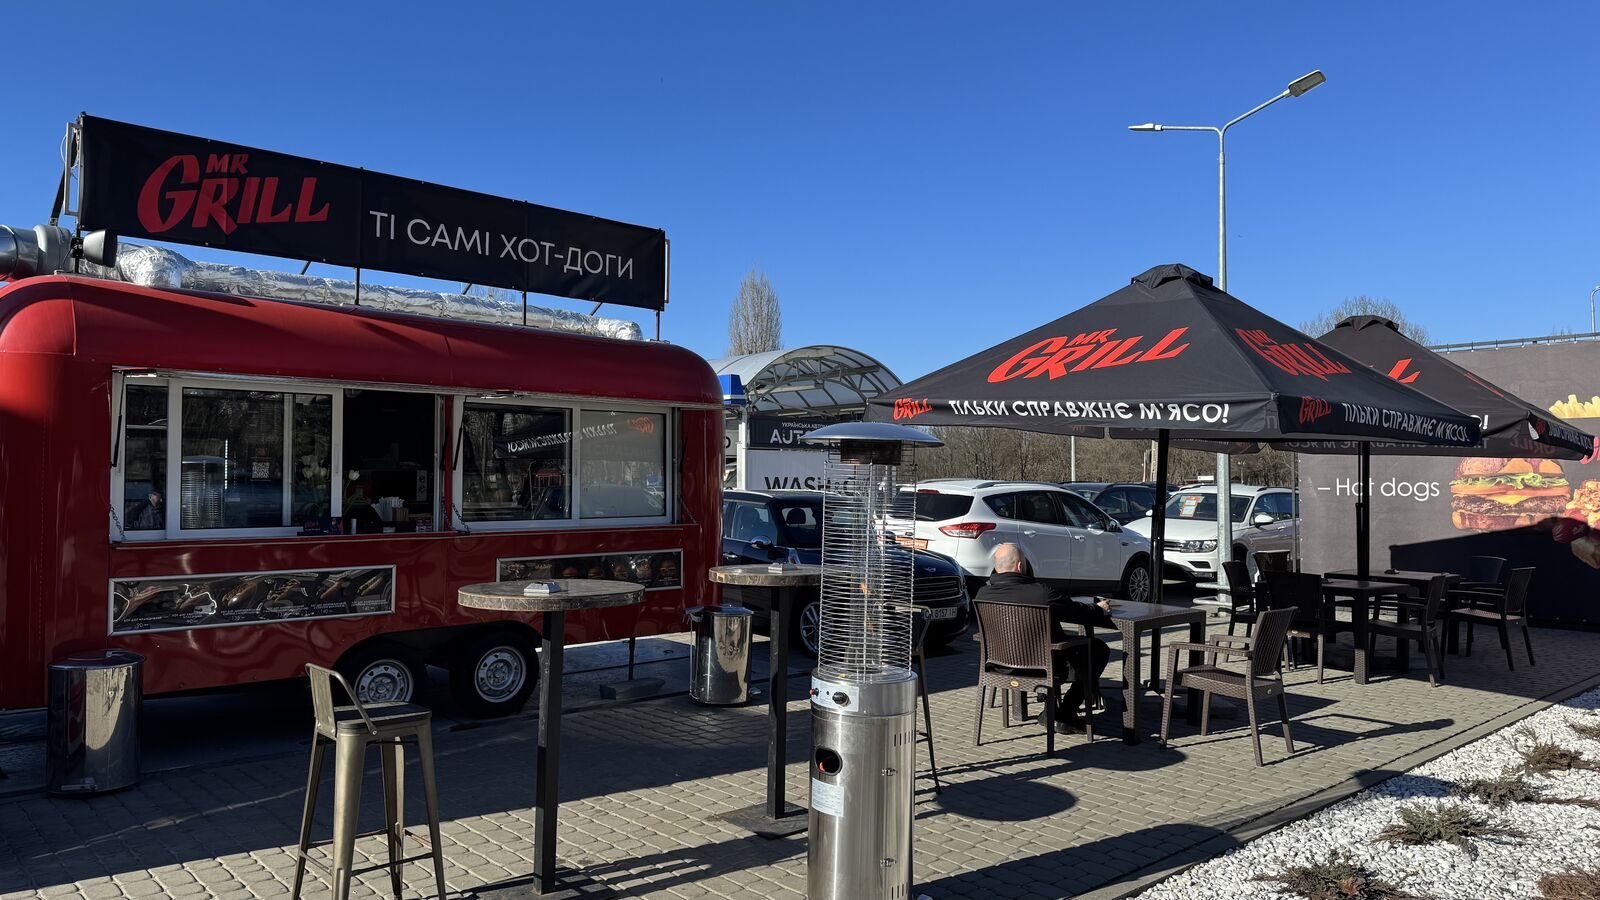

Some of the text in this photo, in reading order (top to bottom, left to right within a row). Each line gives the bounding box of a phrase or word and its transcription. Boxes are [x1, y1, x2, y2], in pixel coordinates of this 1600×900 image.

[205, 153, 248, 175] MR
[138, 154, 330, 236] GRILL
[369, 211, 634, 280] ТІ САМІ ХОТ-ДОГИ
[1066, 328, 1118, 346] MR
[987, 327, 1190, 383] GRILL
[894, 399, 932, 420] GRILL
[948, 400, 1009, 417] ТІЛЬКИ
[1012, 400, 1133, 420] СПРАВЖНЄ
[1341, 402, 1380, 426] ТІЛЬКИ
[1382, 408, 1437, 436] СПРАВЖНЄ
[1380, 477, 1440, 502] dogs
